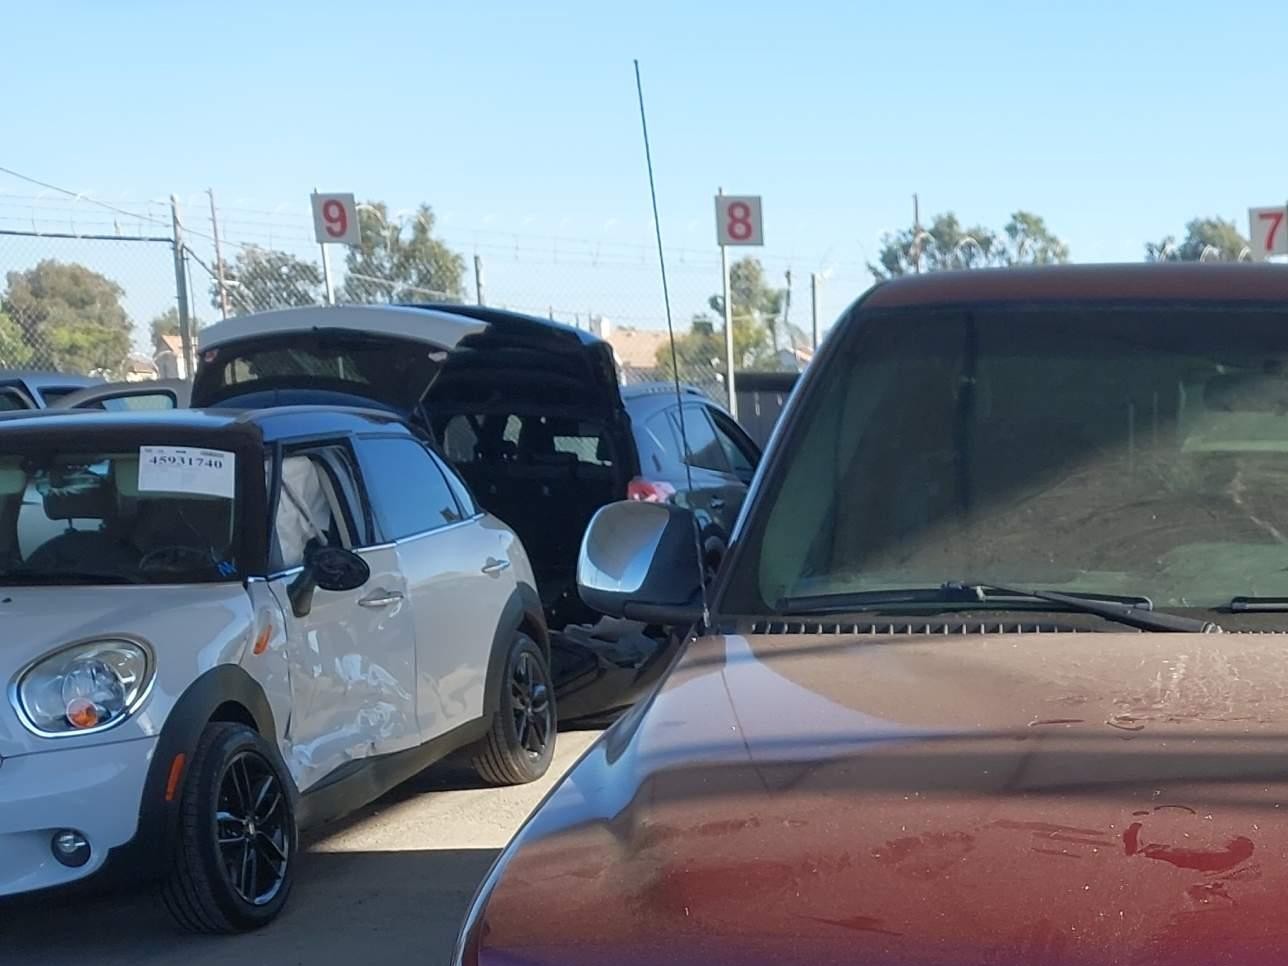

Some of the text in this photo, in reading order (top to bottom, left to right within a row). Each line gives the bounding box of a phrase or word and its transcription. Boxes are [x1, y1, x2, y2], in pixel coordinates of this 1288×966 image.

[322, 199, 348, 238] 9
[727, 200, 752, 241] 8
[1258, 211, 1284, 252] 7
[148, 455, 223, 469] 45931740
